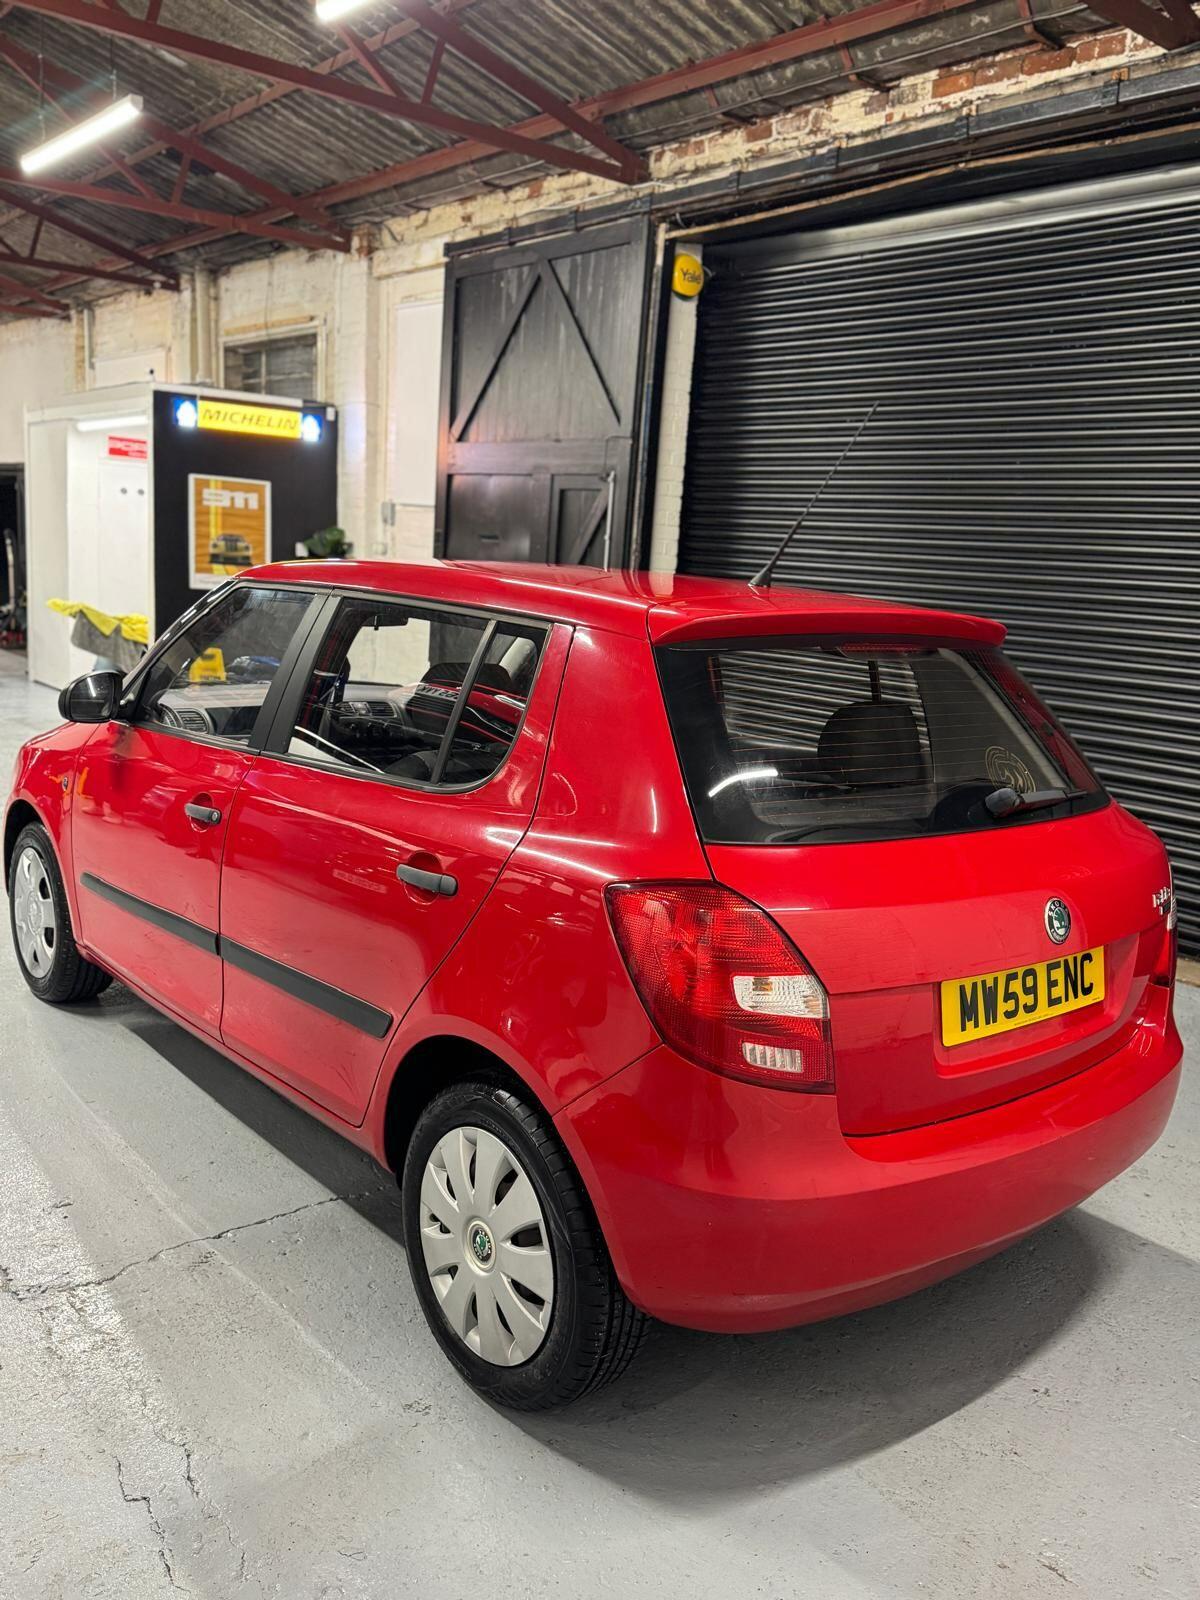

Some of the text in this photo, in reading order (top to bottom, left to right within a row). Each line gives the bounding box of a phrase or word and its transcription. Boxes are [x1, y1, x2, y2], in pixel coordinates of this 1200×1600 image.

[680, 268, 702, 283] Yale
[202, 409, 298, 430] MICHELIN
[203, 489, 258, 510] 911
[959, 952, 1094, 1032] MW59 ENC
